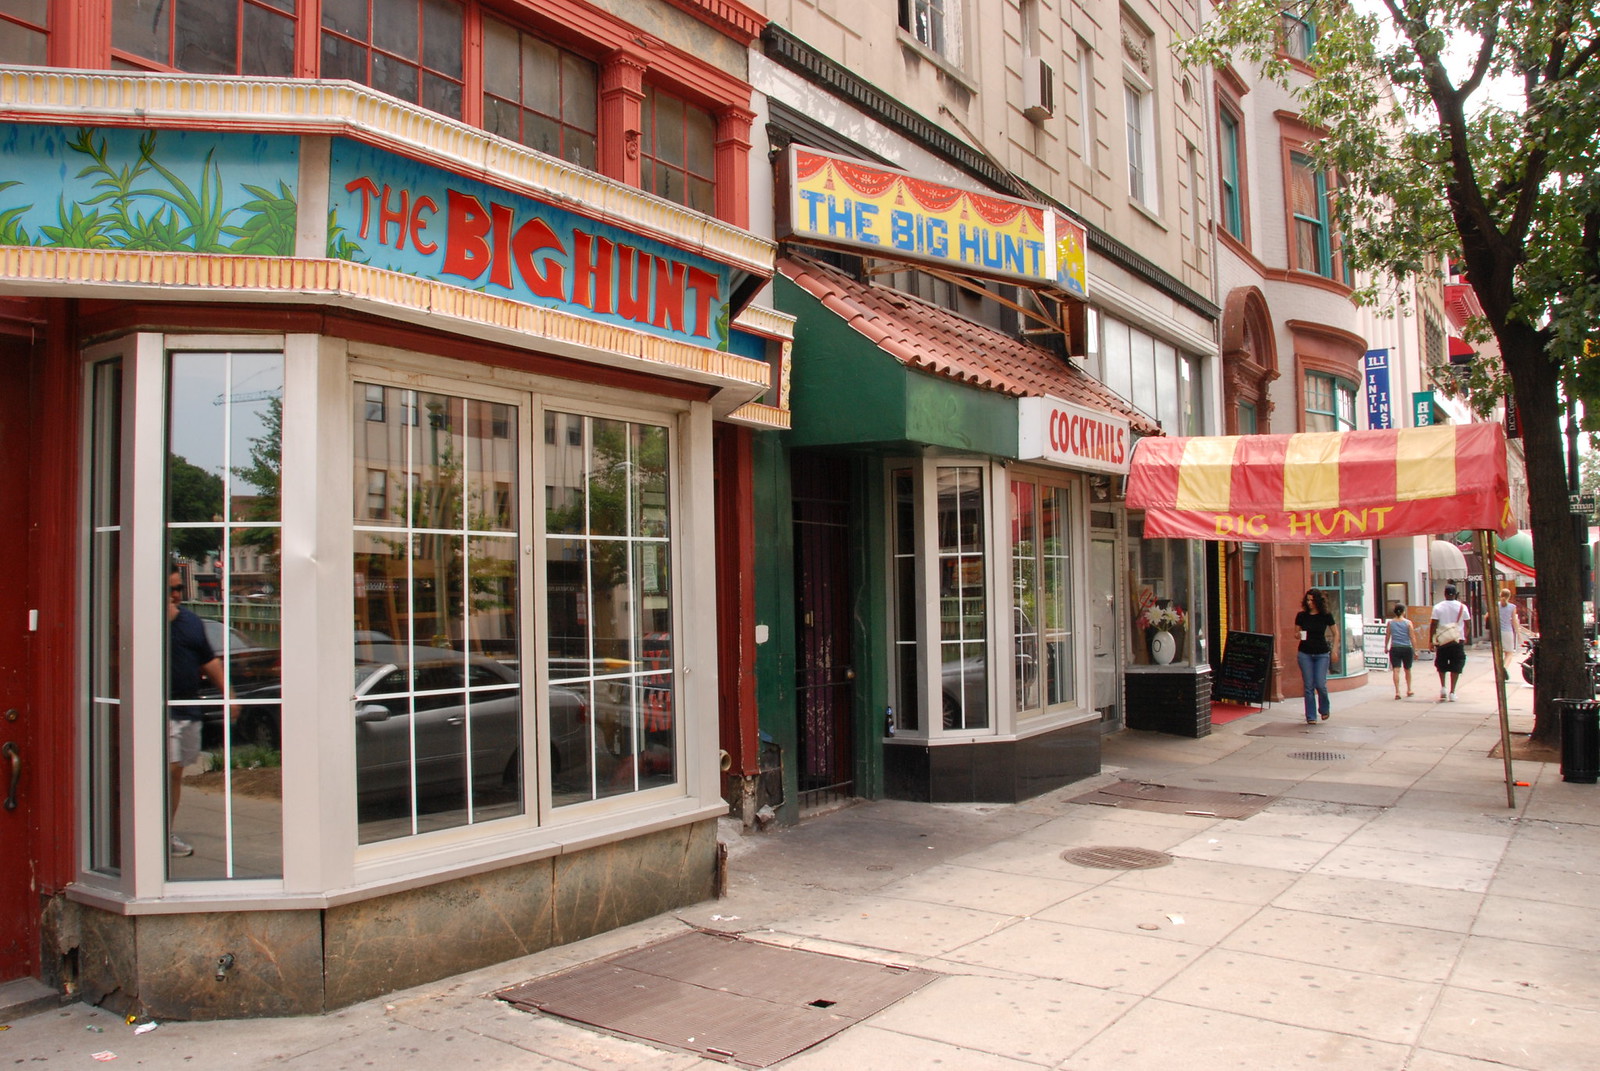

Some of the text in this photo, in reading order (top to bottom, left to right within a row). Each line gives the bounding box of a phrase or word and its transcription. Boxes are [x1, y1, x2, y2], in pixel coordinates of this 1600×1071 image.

[344, 175, 721, 339] THE BIG HUNT
[798, 189, 1046, 276] THE BIG HUNT
[1049, 408, 1125, 465] COCKTAILS
[1213, 506, 1395, 537] BIG HUNT
